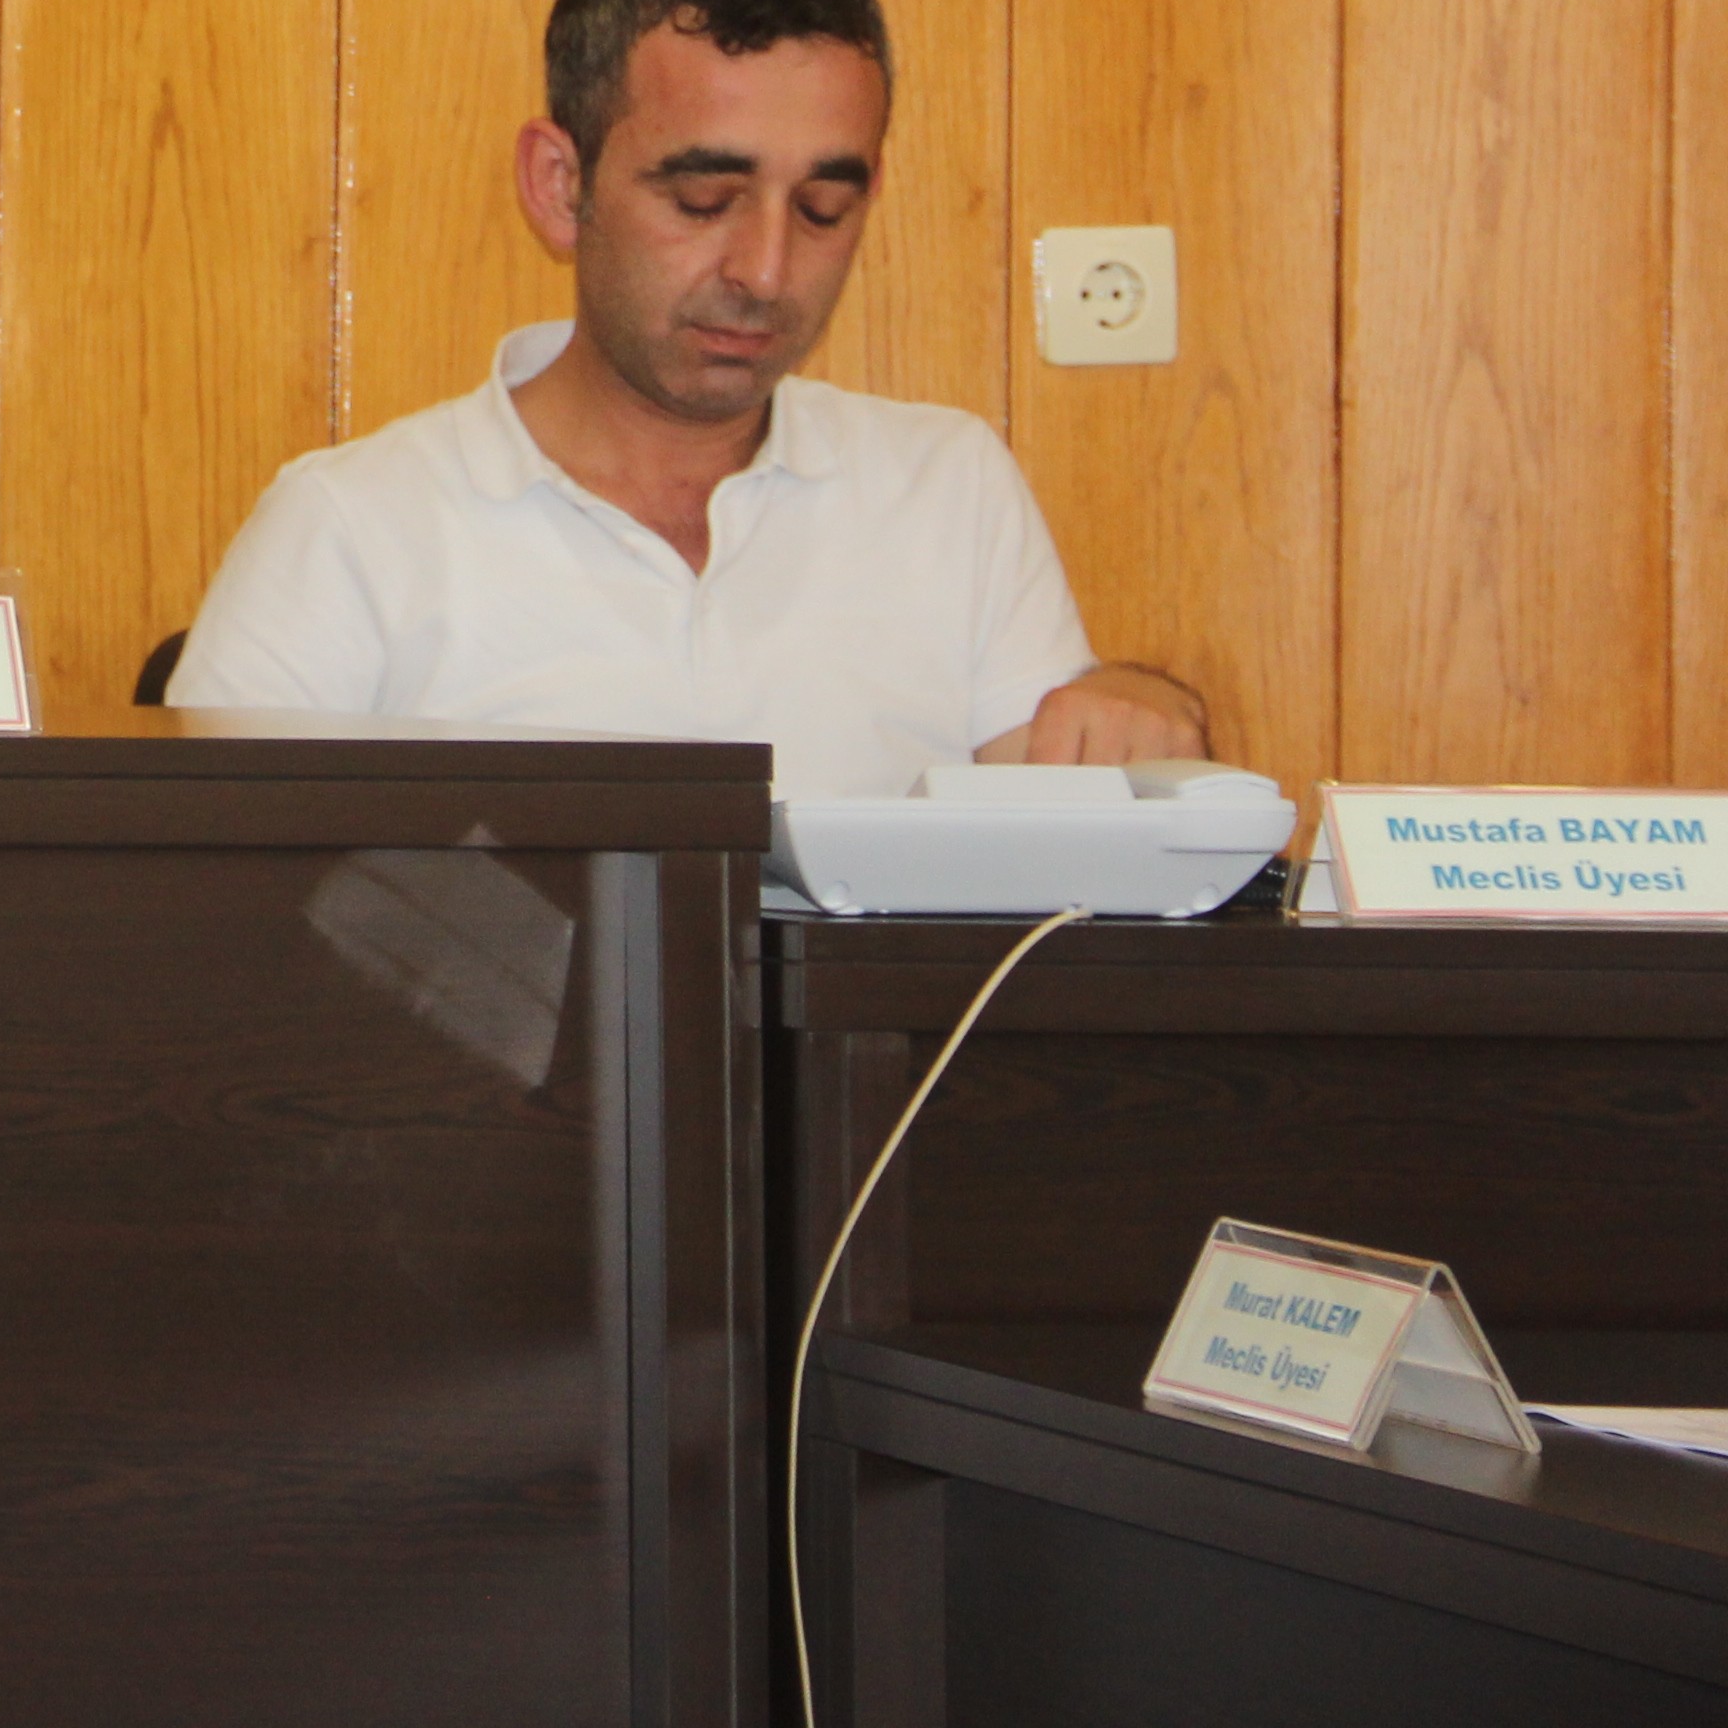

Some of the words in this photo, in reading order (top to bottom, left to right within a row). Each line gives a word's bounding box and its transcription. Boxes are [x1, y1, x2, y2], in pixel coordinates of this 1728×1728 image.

[1387, 817, 1545, 843] Mustafa
[1560, 818, 1707, 844] BAYAM
[1432, 865, 1562, 890] Meclis
[1575, 861, 1686, 896] Üyesi
[1223, 1281, 1283, 1320] Murat
[1284, 1296, 1361, 1338] KALEM
[1204, 1336, 1267, 1377] Meclis
[1270, 1345, 1329, 1391] Üyesi
